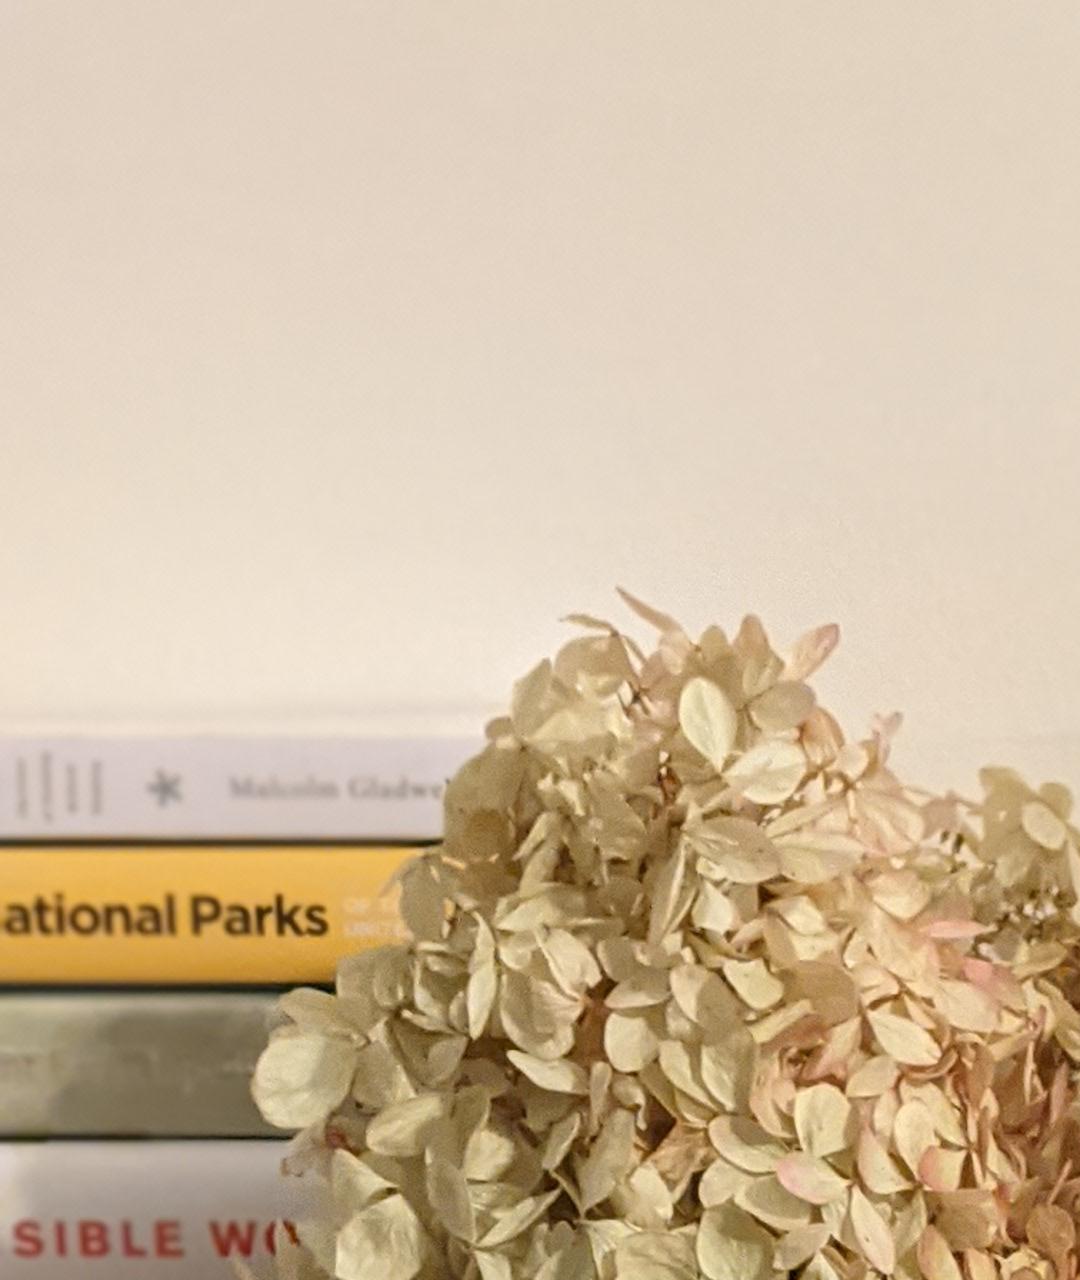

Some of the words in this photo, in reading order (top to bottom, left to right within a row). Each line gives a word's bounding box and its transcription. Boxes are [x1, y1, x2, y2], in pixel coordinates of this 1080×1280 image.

[229, 774, 339, 799] Malcolm
[348, 775, 448, 799] Gladwe
[191, 894, 329, 937] Parks
[12, 1219, 185, 1259] SIBLE
